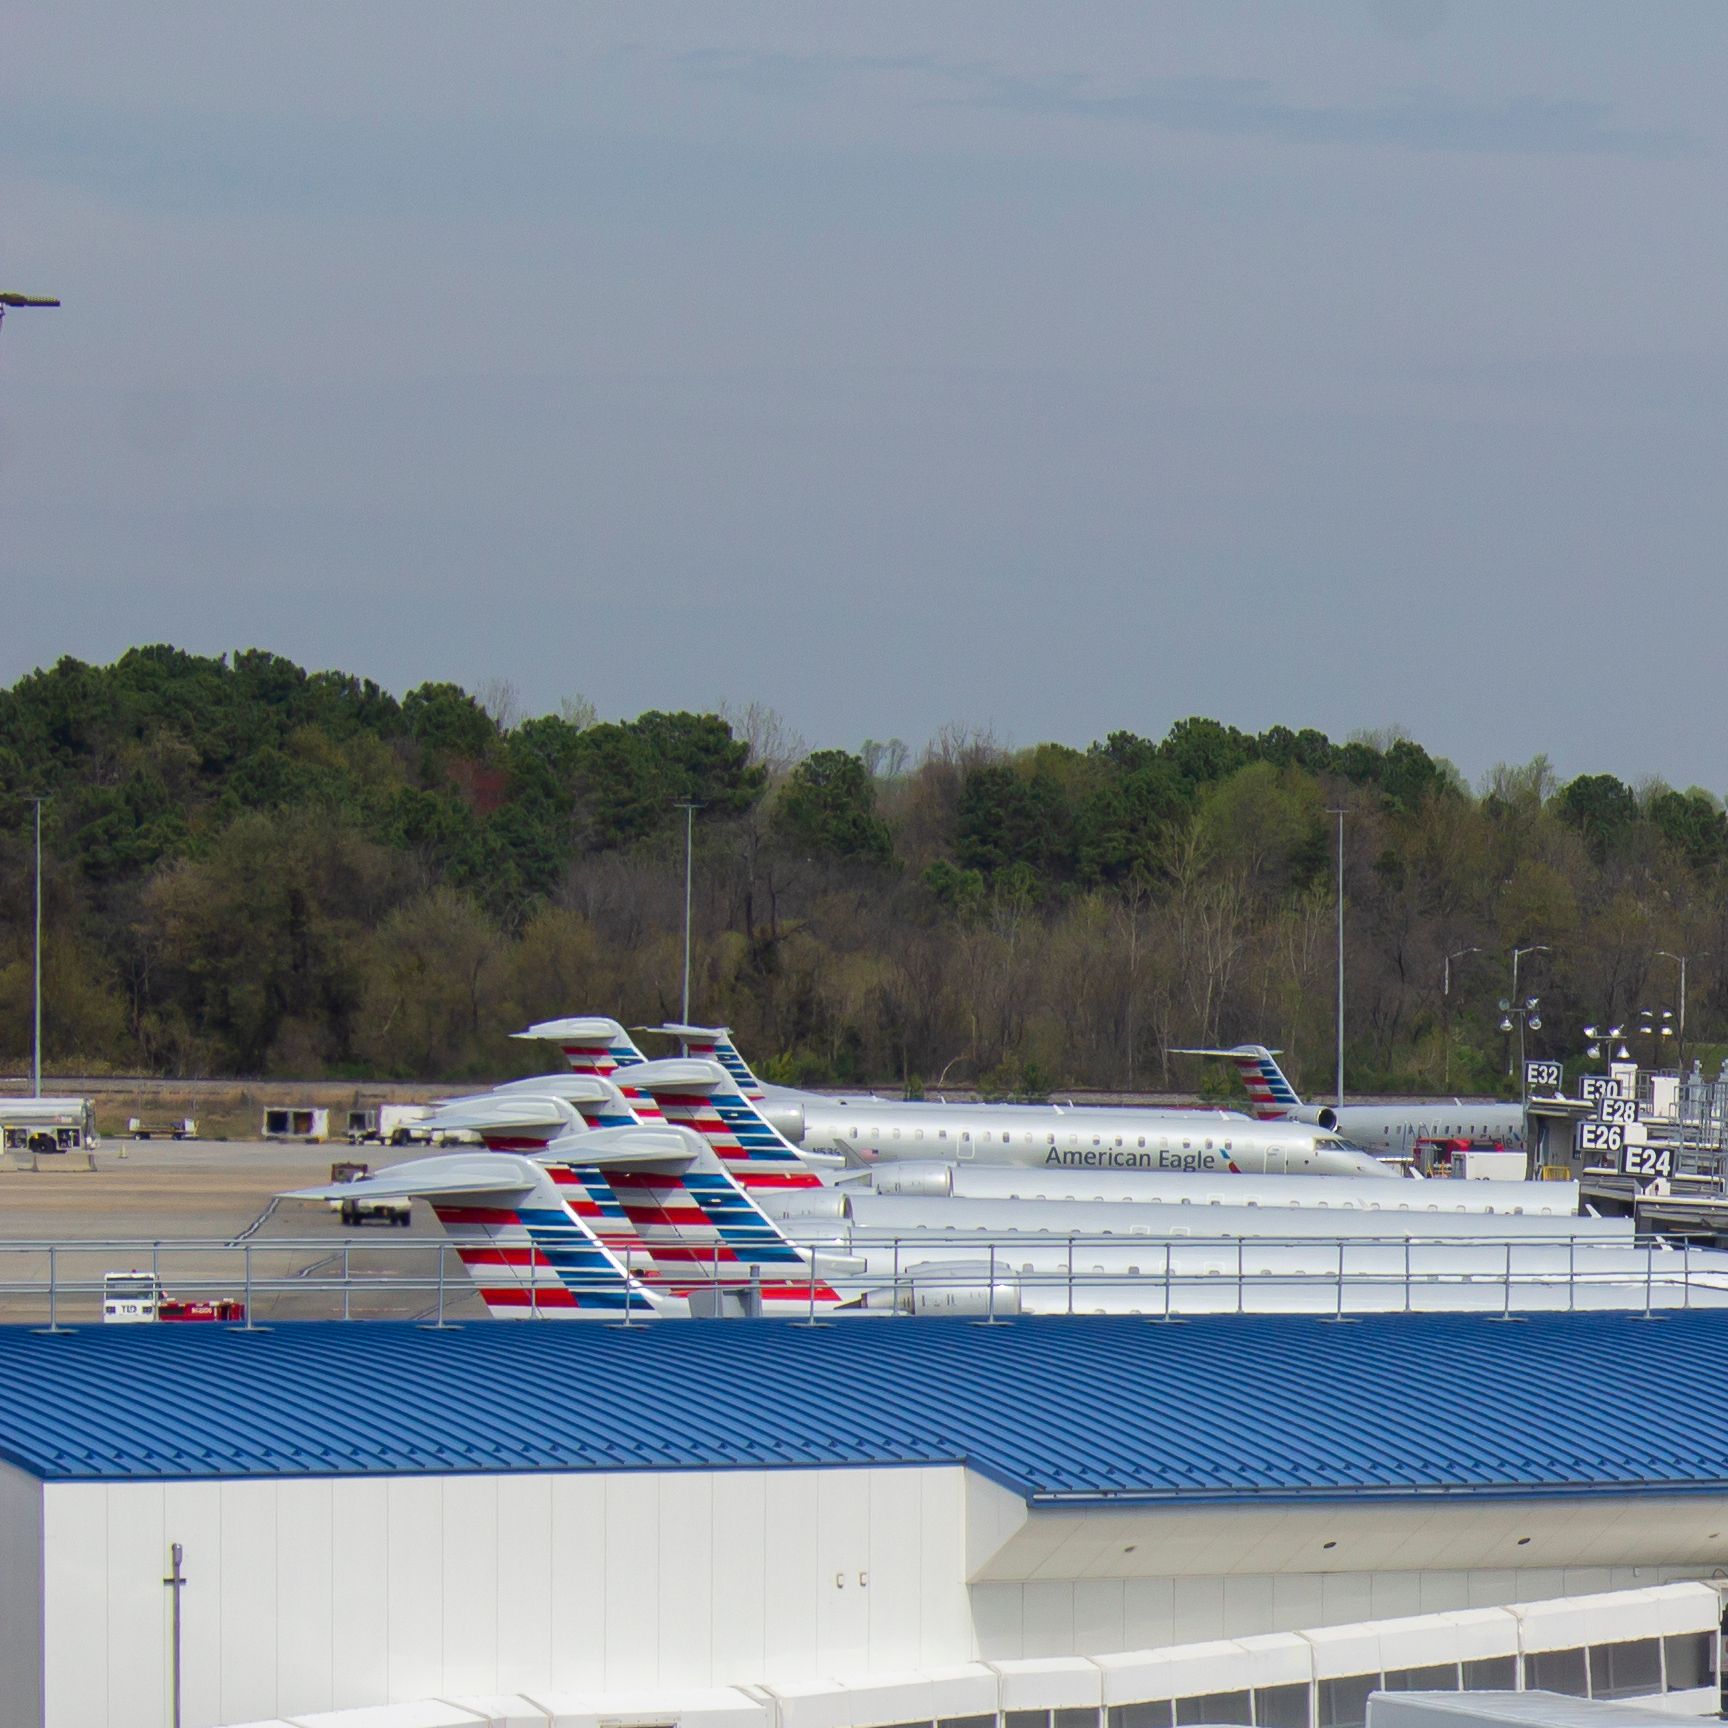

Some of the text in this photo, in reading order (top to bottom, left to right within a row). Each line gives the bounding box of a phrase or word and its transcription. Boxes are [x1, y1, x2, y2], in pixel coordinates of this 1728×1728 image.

[1527, 1063, 1558, 1085] E32
[1583, 1079, 1618, 1100] E30
[1601, 1100, 1636, 1123] E28
[1582, 1124, 1621, 1150] E26
[1044, 1147, 1215, 1172] American Eagle
[1625, 1147, 1671, 1176] E24
